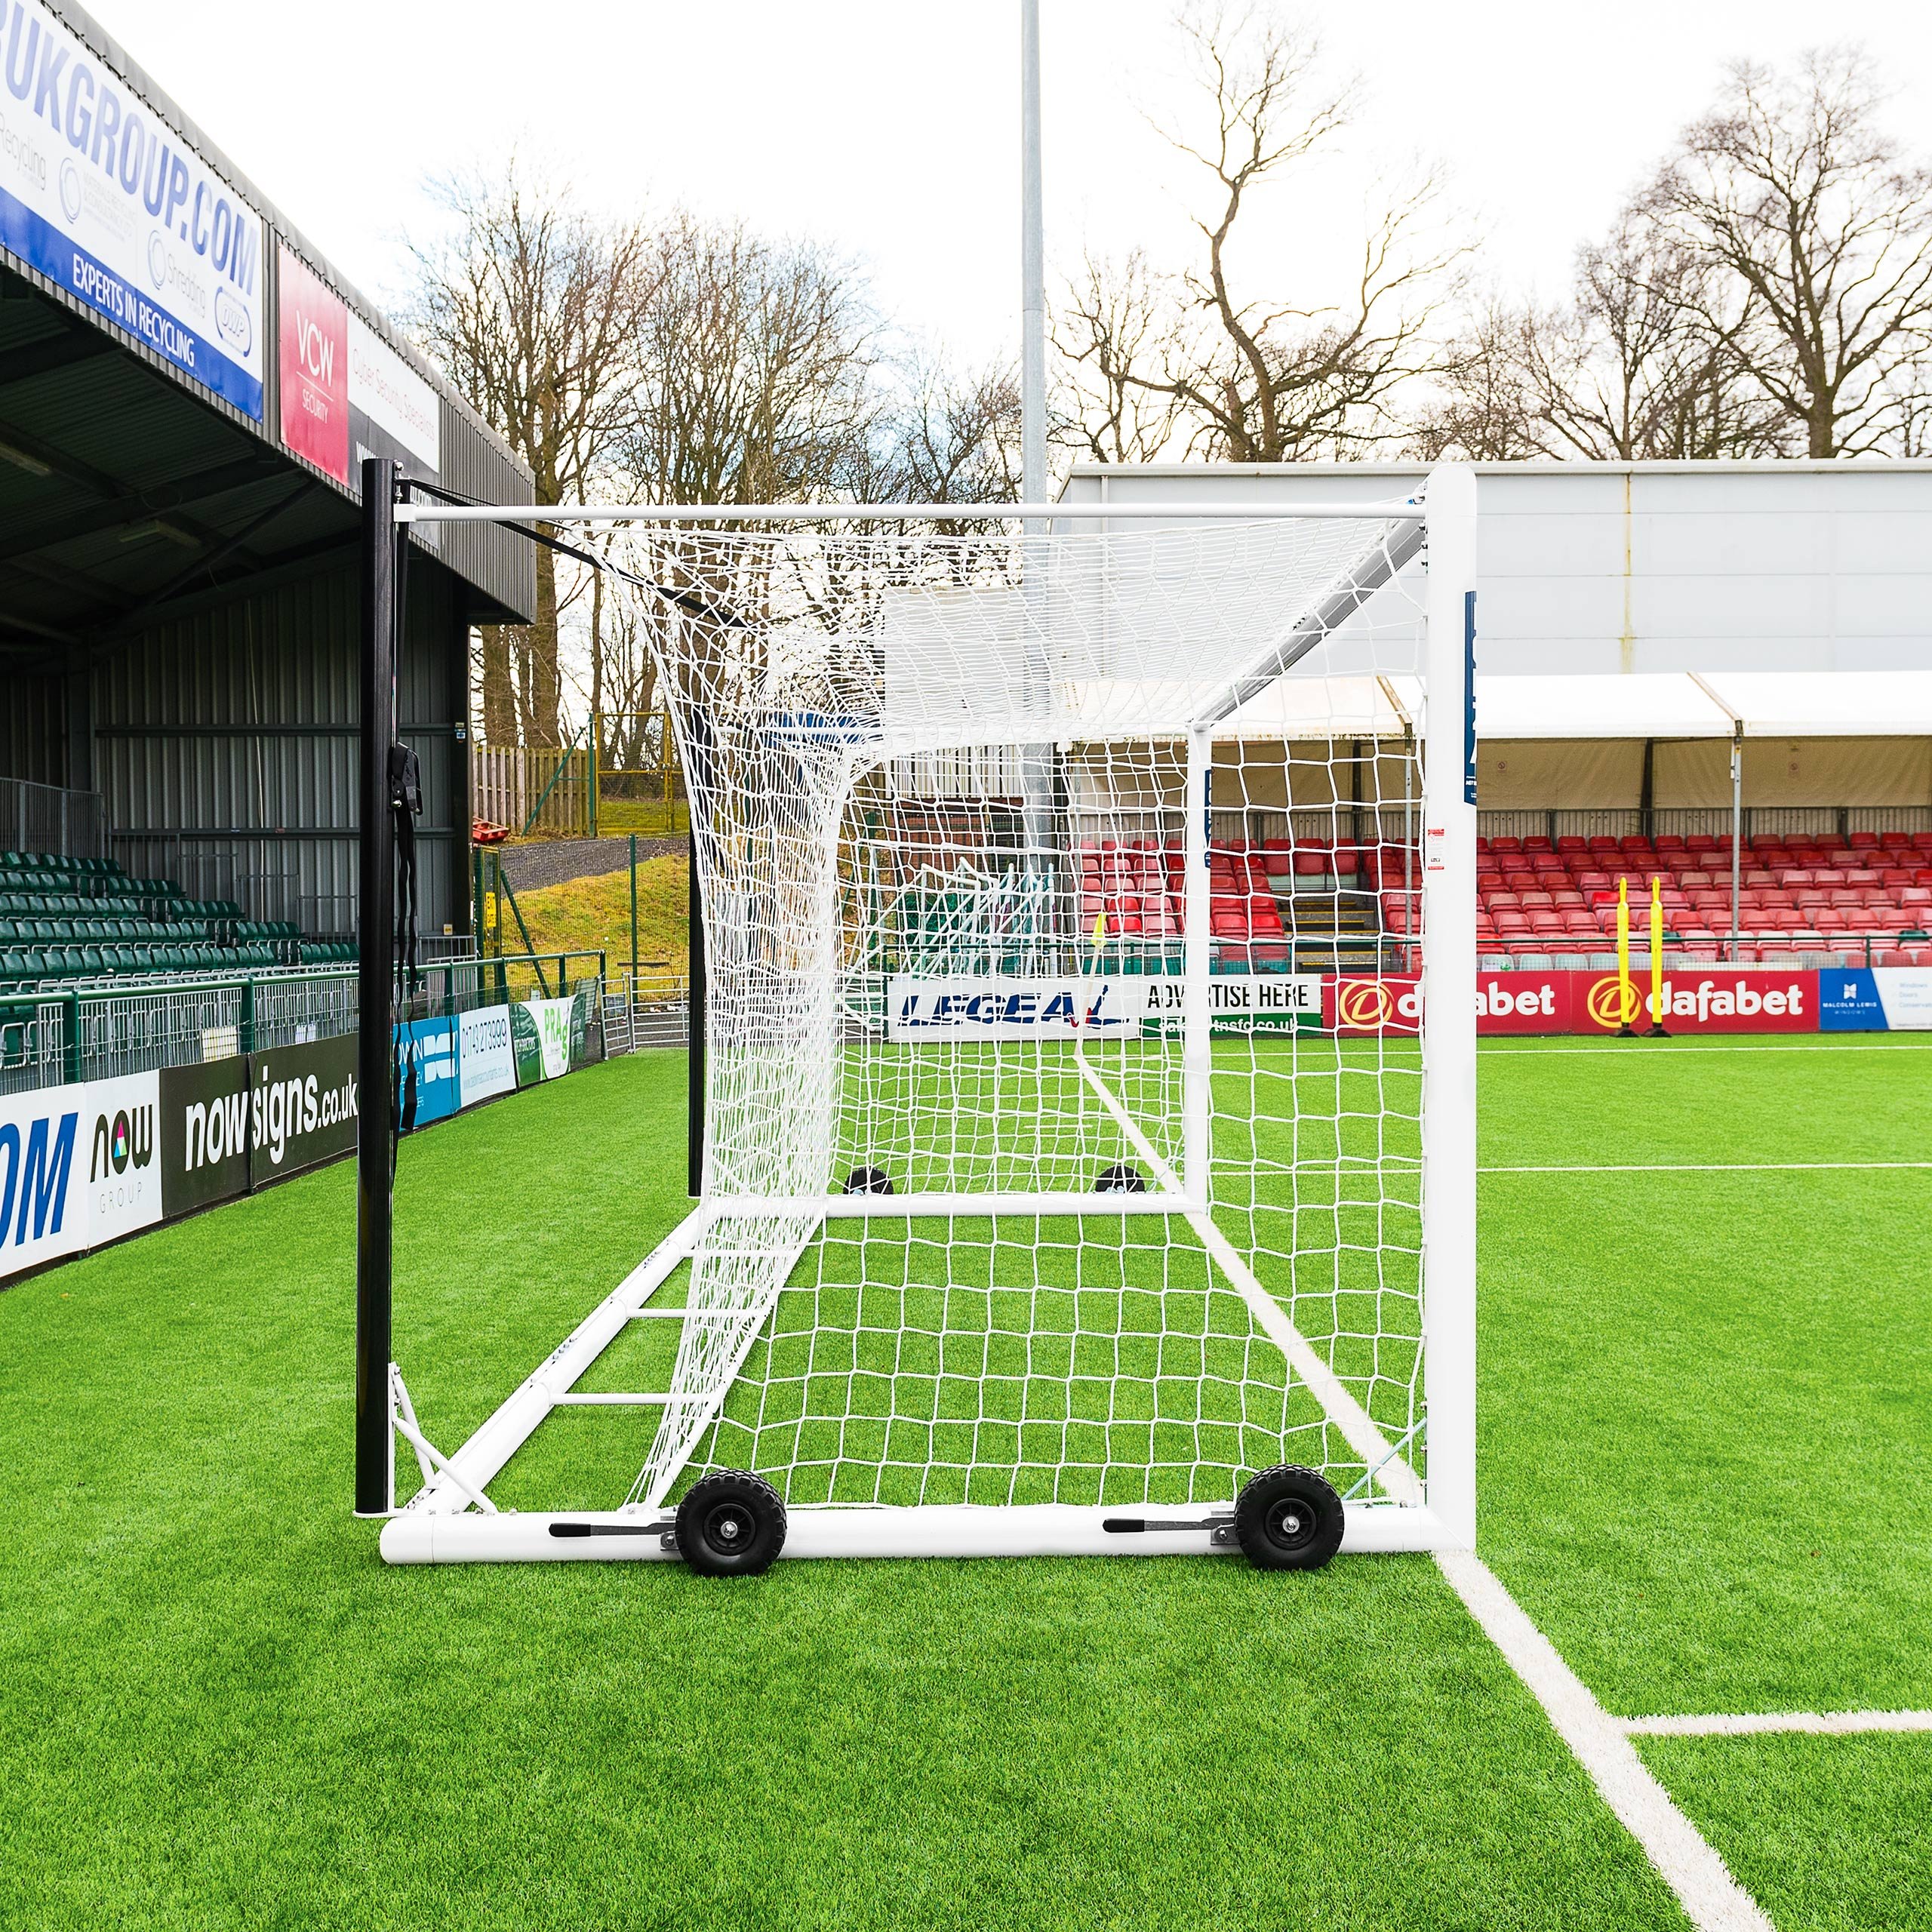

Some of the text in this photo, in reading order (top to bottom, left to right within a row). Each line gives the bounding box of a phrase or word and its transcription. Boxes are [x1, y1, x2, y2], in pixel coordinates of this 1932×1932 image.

[73, 253, 195, 368] EXPERTS IN RECYCLING
[296, 309, 334, 387] VCW
[302, 388, 328, 423] SECURITY
[1259, 983, 1309, 1007] HERE
[1645, 980, 1803, 1022] dafabet
[100, 1182, 142, 1214] GROUP
